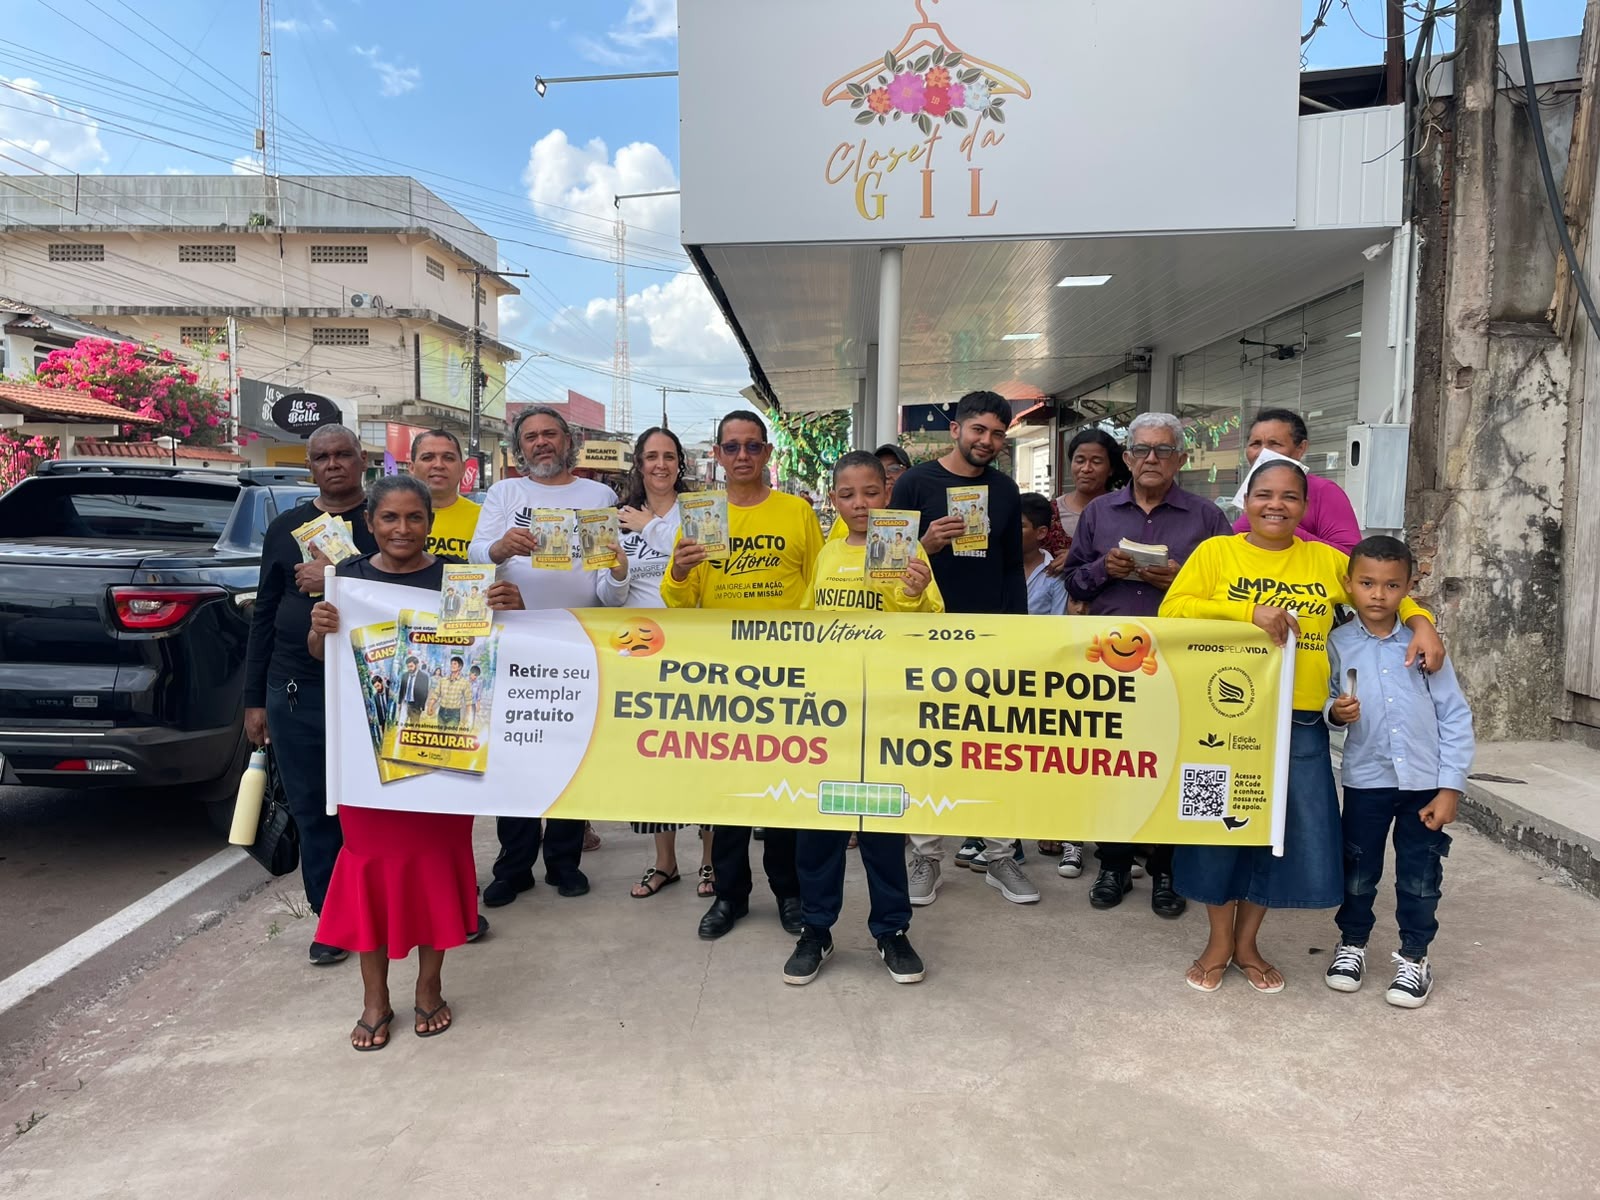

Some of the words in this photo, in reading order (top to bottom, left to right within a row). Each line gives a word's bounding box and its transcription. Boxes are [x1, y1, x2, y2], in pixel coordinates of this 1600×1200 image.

[824, 123, 942, 184] Closet
[959, 114, 1005, 161] da
[290, 400, 305, 413] La
[288, 409, 320, 424] Bella
[423, 536, 471, 552] PACT
[729, 535, 786, 551] PACTO
[724, 551, 781, 575] Vitória
[724, 591, 742, 599] POVO
[757, 589, 783, 598] MISSÃO
[727, 583, 751, 591] IGREJA
[1237, 577, 1327, 598] IMPACTO
[731, 620, 815, 642] IMPACTO
[816, 618, 887, 643] Vitória
[928, 629, 976, 641] 2026
[412, 633, 470, 645] CANSADOS
[368, 646, 396, 661] CANS
[1187, 644, 1268, 655] #TODOSPELAVIDA
[509, 663, 559, 678] Retire
[562, 668, 590, 680] seu
[659, 659, 729, 685] POR
[735, 664, 806, 690] QUE
[904, 667, 925, 691] E
[931, 667, 958, 693] O
[964, 667, 1037, 699] QUE
[1044, 671, 1136, 702] PODE
[507, 686, 582, 703] exemplar
[505, 708, 574, 724] gratuito
[613, 690, 775, 724] ESTAMOS
[779, 691, 848, 728] TÃO
[918, 701, 1123, 740] REALMENTE
[401, 731, 475, 749] RESTAURAR
[503, 729, 544, 746] aqui!
[1232, 735, 1257, 744] Edição
[636, 729, 829, 765] CANSADOS
[1232, 743, 1262, 751] Especial
[879, 737, 953, 768] NOS
[961, 741, 1158, 778] RESTAURAR
[1241, 803, 1262, 811] apoio.
